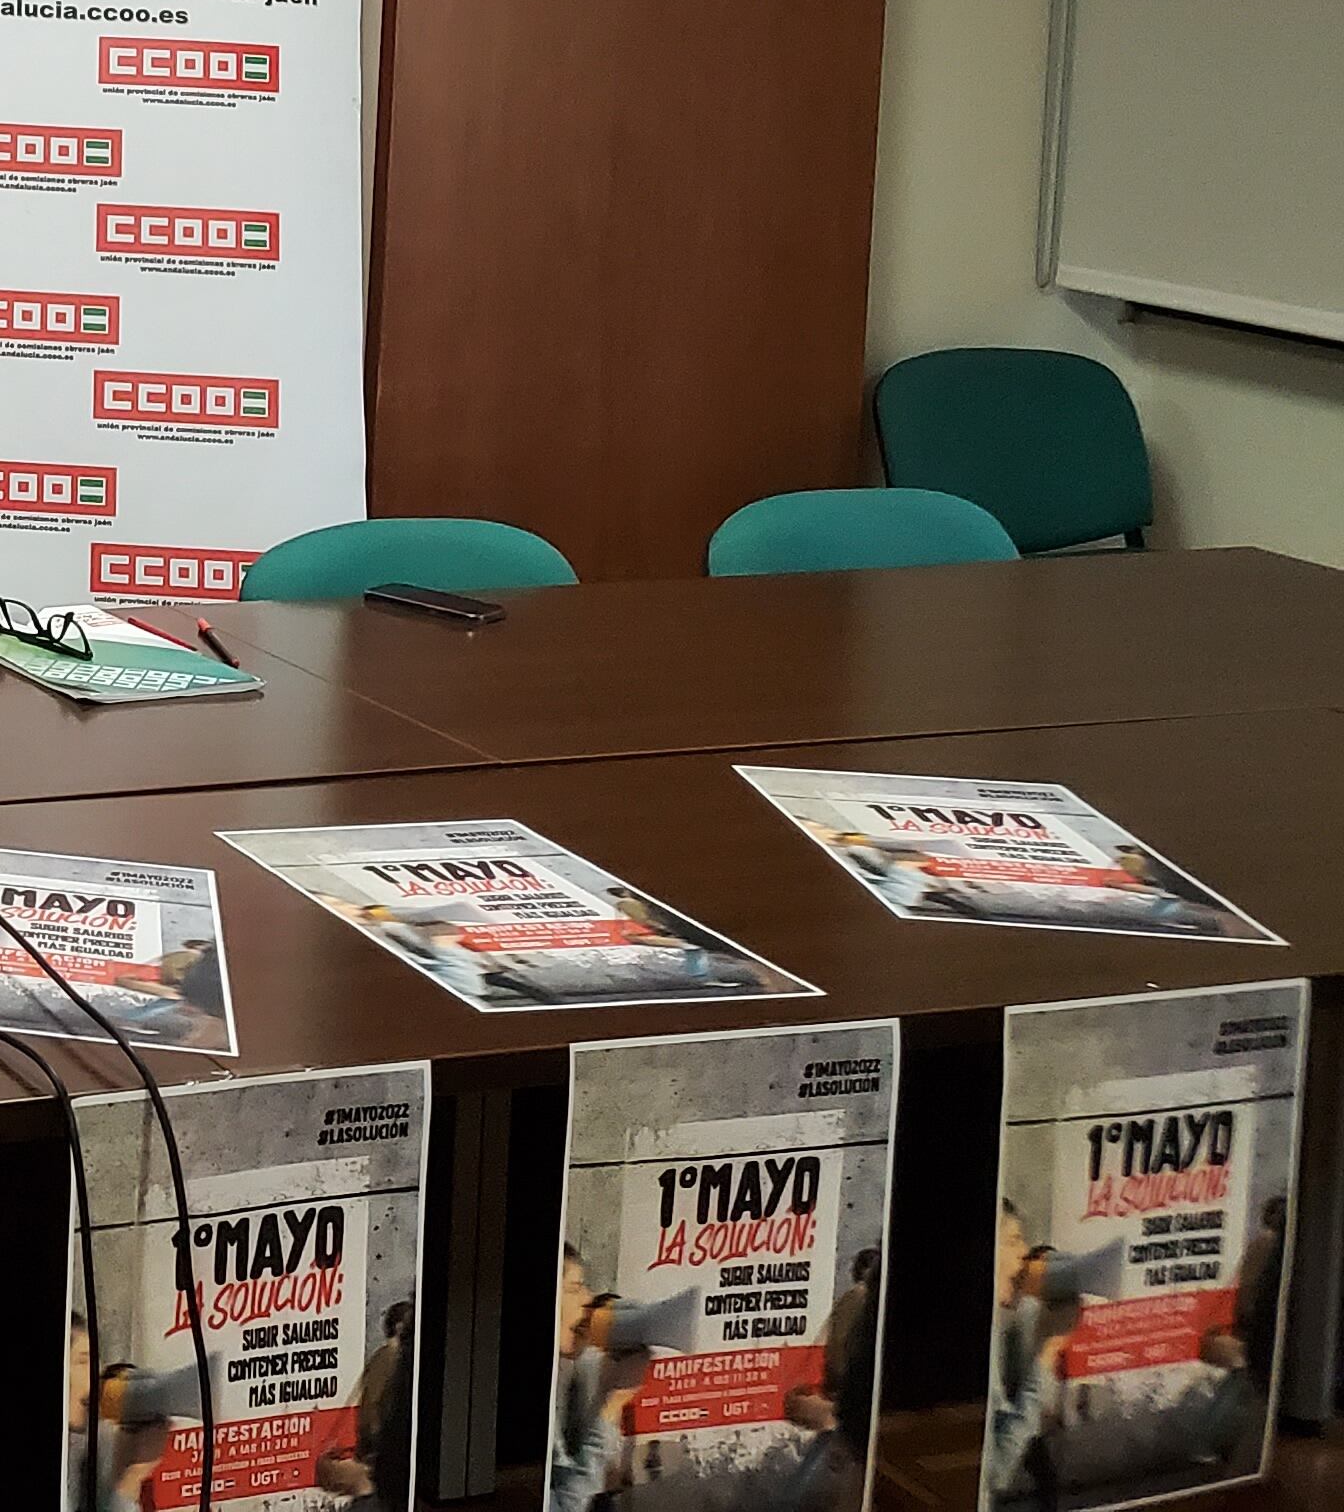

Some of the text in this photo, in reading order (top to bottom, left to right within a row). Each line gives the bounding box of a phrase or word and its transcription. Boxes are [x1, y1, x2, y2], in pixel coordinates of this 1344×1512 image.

[108, 46, 238, 83] CCOO
[105, 214, 237, 250] CCOO
[102, 380, 236, 417] CCOO
[99, 554, 234, 592] CCOO
[323, 1102, 410, 1126] #1MAYO2022
[316, 1120, 409, 1146] #LASOLUCIÓN
[722, 1316, 750, 1341] MÁS
[227, 1347, 339, 1383] CONTENER PRECIOS
[248, 1375, 339, 1409] MÁS IGUALDAD
